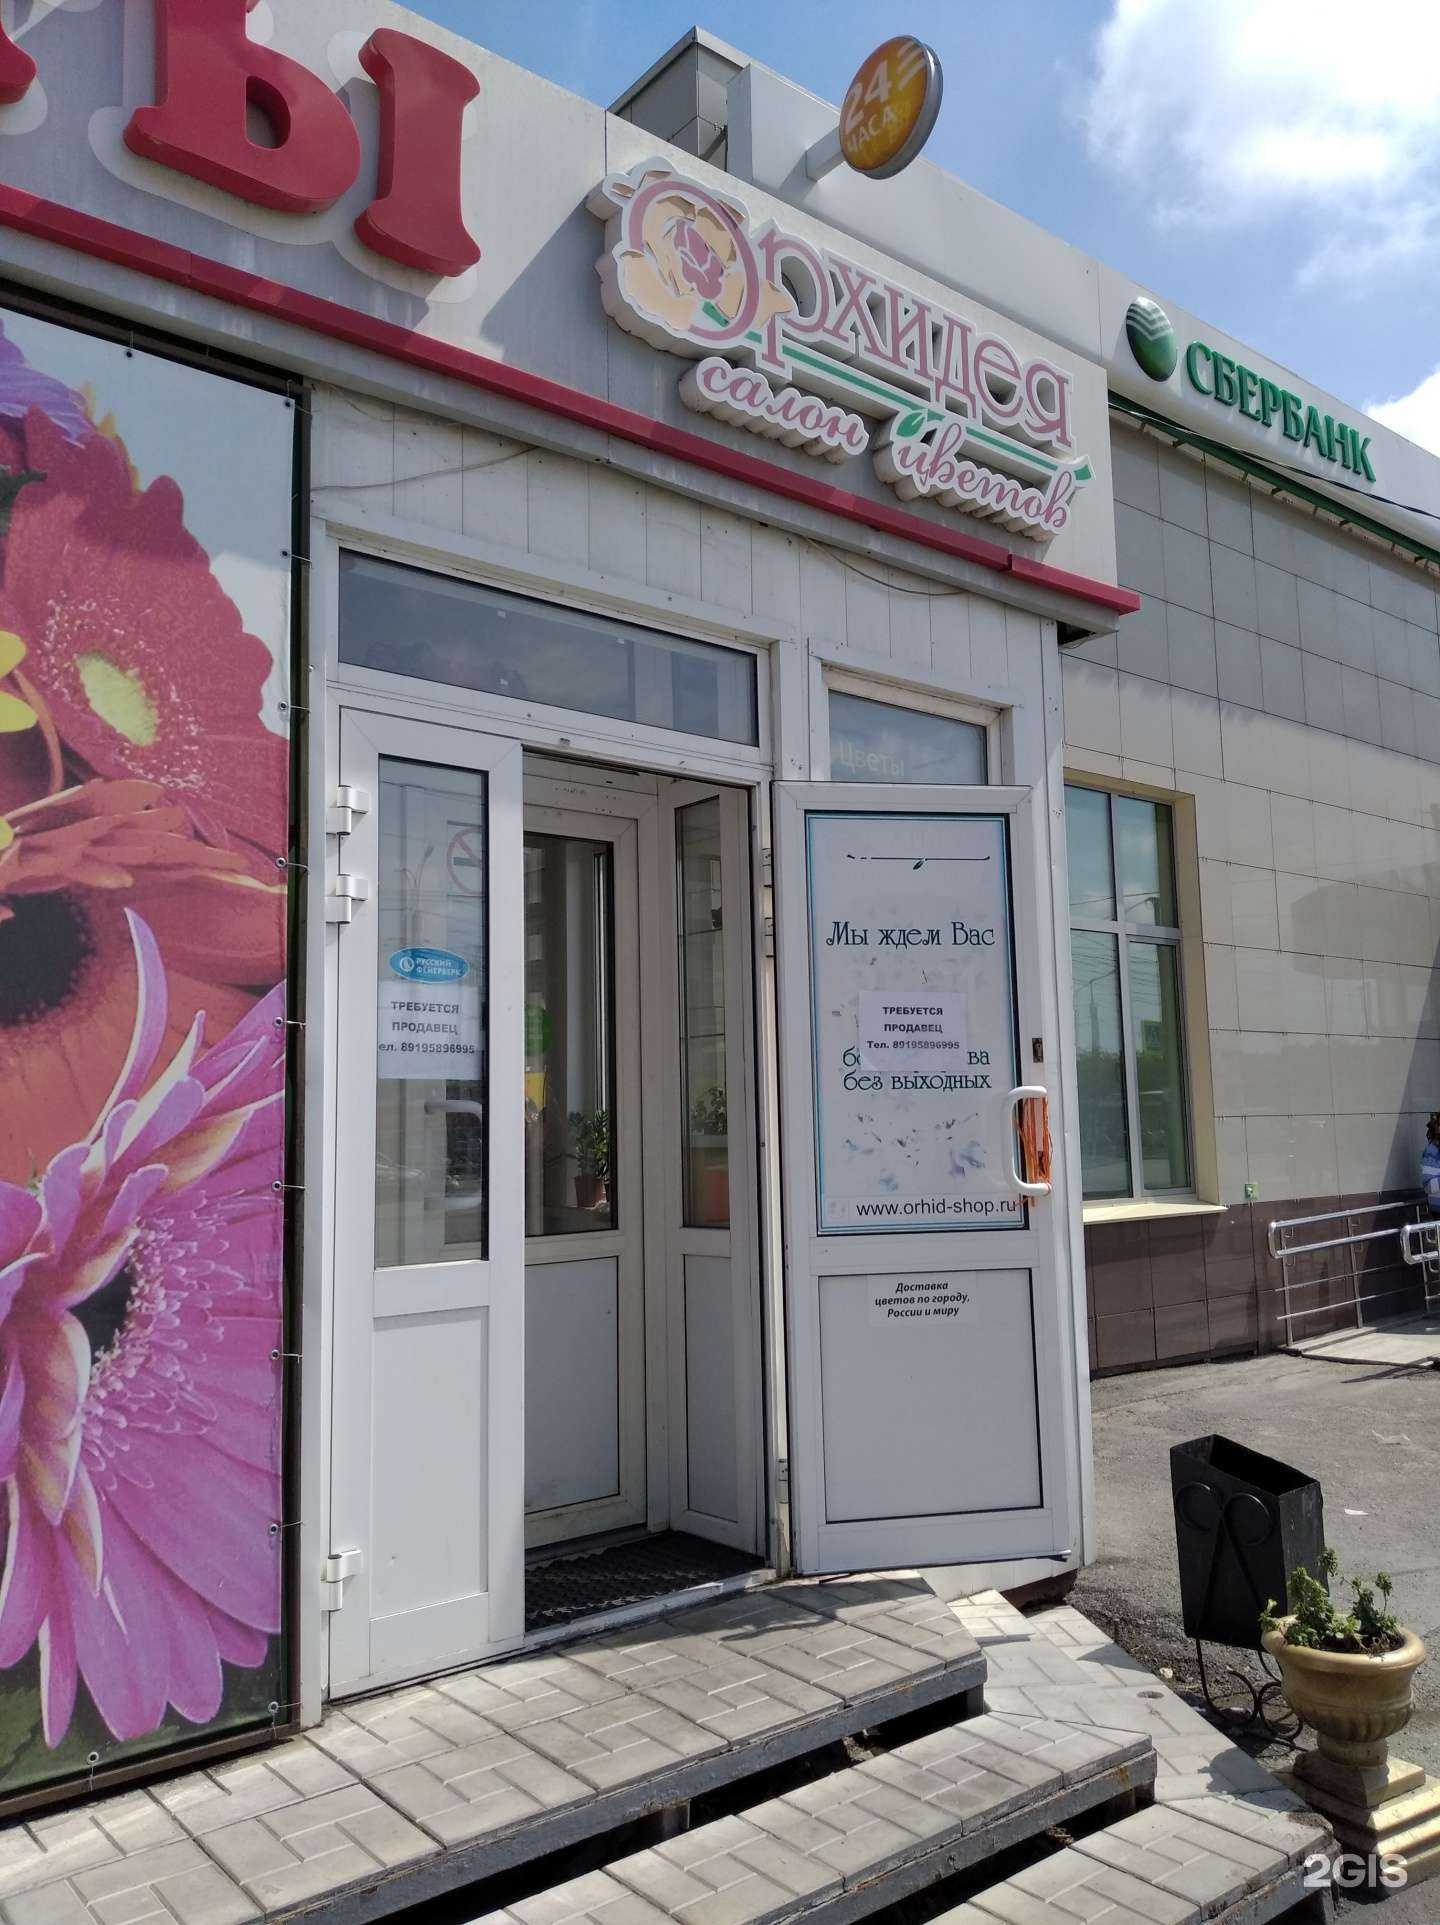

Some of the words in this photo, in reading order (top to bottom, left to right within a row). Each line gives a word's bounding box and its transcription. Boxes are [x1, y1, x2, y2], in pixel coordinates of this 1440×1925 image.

[844, 60, 893, 136] 24
[847, 104, 897, 154] ЧАСА
[628, 179, 1073, 449] Орхидея
[702, 363, 866, 448] салон
[1185, 340, 1377, 483] СБЕРБАНК
[897, 422, 1070, 529] цветов
[825, 921, 868, 946] Мы
[878, 928, 942, 949] ждем
[951, 921, 996, 946] Вас
[391, 1001, 460, 1014] ТРЕБУЕТСЯ
[882, 1006, 944, 1016] ТРЕБУЕТСЯ
[391, 1021, 458, 1035] ПРОДАВЕЦ
[884, 1023, 944, 1034] ПРОДАВЕЦ
[378, 1043, 397, 1052] ел.
[867, 1040, 890, 1049] Тел.
[843, 1069, 883, 1091] без
[890, 1074, 993, 1093] выходных
[856, 1198, 1016, 1216] www.orhid-shop.ru
[895, 1280, 949, 1294] Доставка
[874, 1295, 915, 1307] цветов
[917, 1295, 931, 1304] по
[932, 1291, 970, 1304] городу,
[887, 1308, 923, 1318] России
[924, 1308, 932, 1316] и
[933, 1306, 960, 1317] миру
